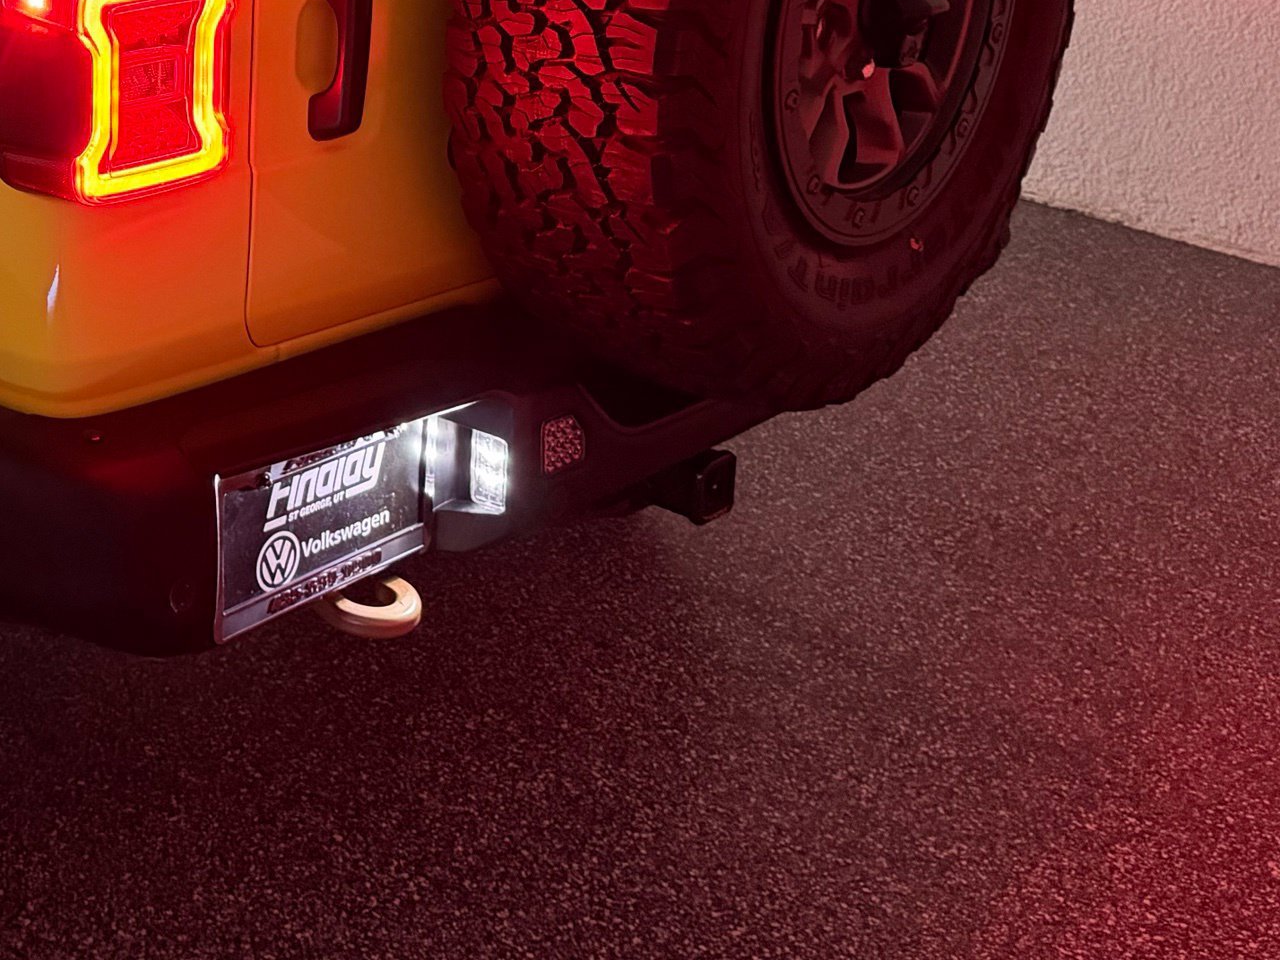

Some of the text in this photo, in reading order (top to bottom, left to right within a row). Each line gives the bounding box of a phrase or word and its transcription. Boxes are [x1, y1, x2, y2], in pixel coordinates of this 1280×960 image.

[265, 441, 386, 520] Findlay
[288, 491, 346, 521] ST GEORGE, UT
[301, 510, 391, 558] Volkswagen
